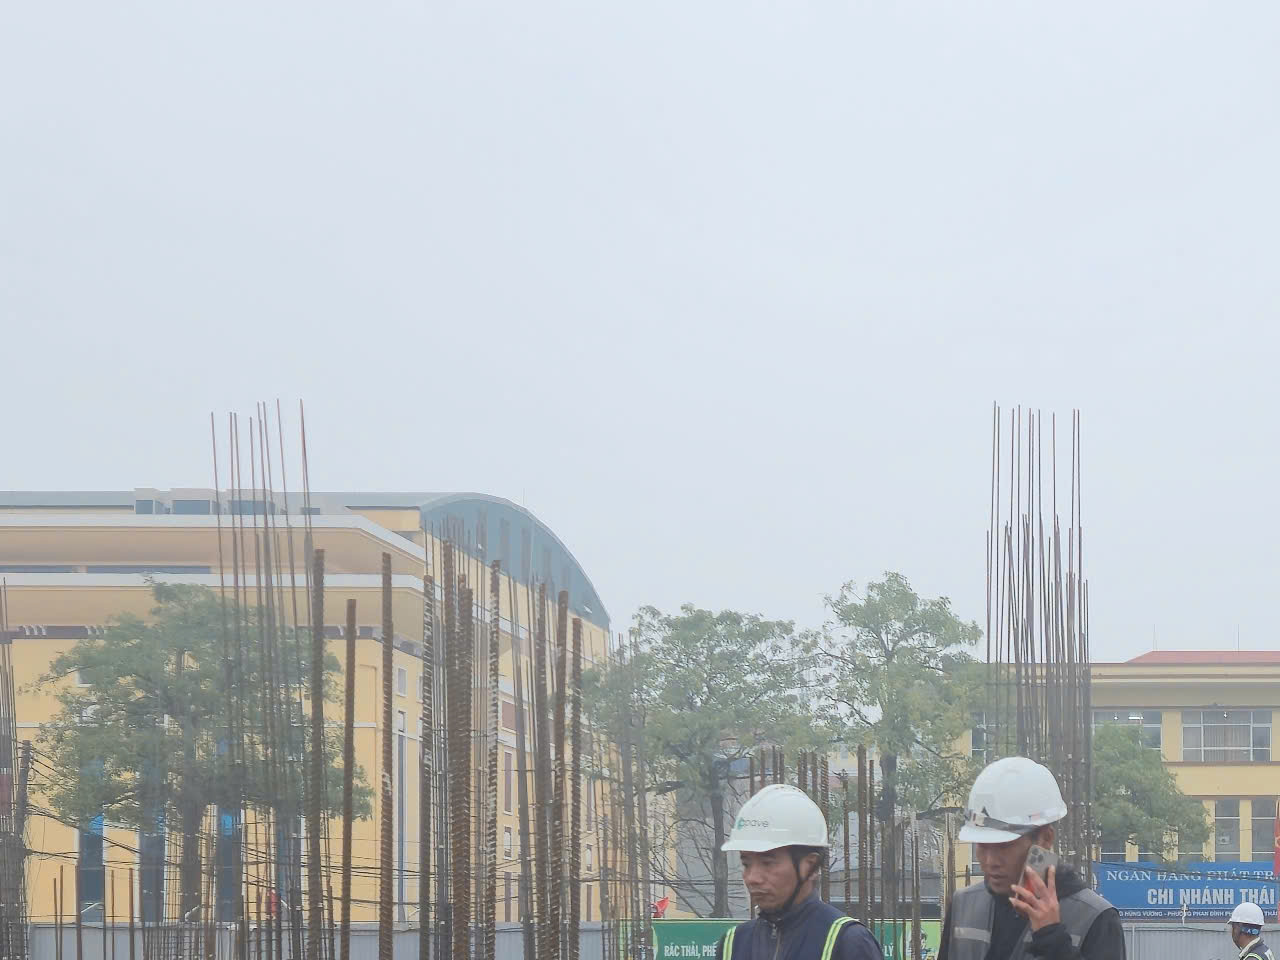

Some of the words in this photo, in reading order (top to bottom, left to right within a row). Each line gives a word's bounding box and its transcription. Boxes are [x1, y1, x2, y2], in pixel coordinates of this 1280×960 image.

[1147, 888, 1174, 905] CHI
[1180, 885, 1235, 905] NHÁNH
[1240, 885, 1275, 905] THÁI
[664, 941, 680, 957] RÁC
